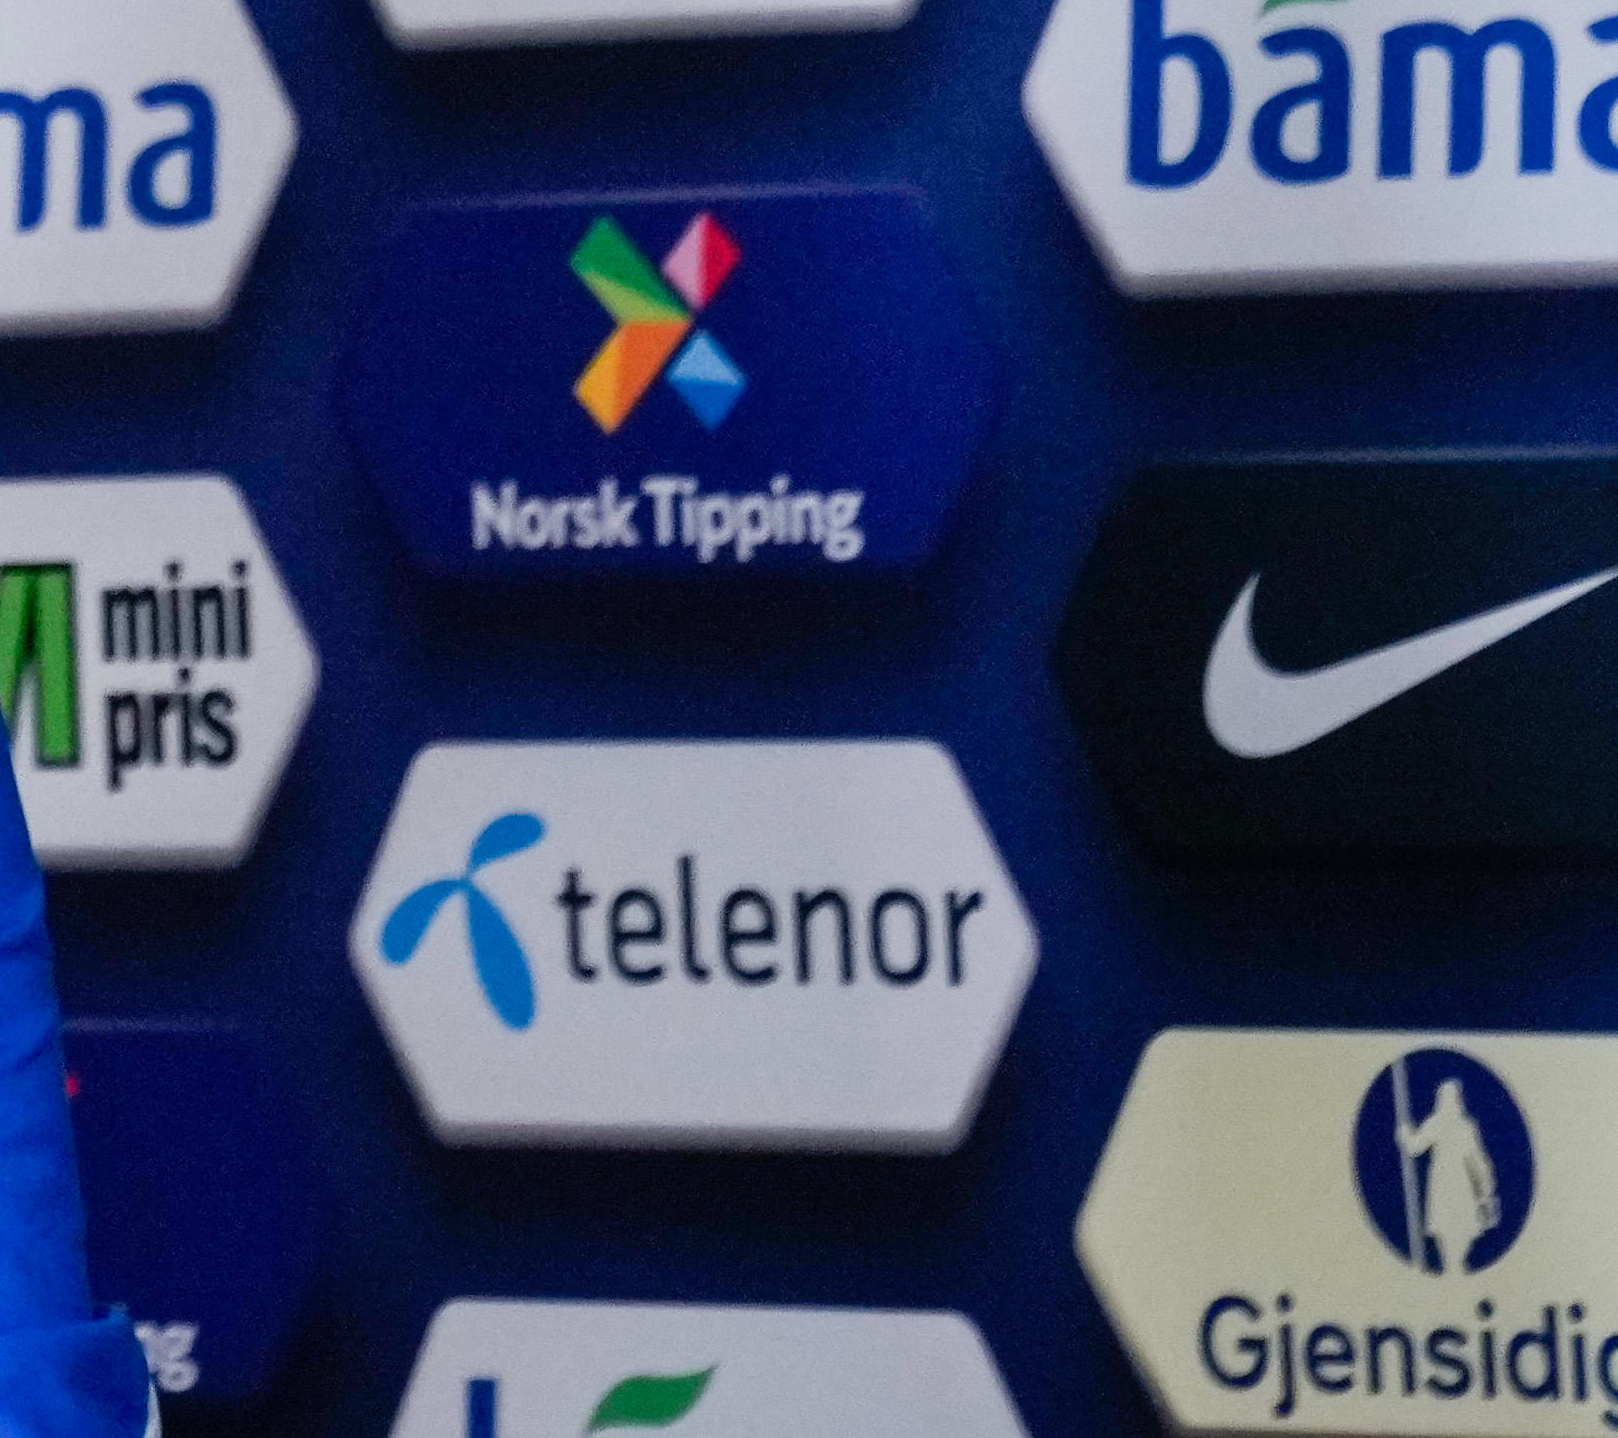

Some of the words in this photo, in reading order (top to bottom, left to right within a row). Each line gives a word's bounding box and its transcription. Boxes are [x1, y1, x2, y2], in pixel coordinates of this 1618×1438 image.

[469, 476, 639, 552] Norsk
[639, 474, 866, 564] Tipping
[101, 558, 252, 662] mini
[104, 665, 240, 792] pris
[556, 853, 984, 990] telenor
